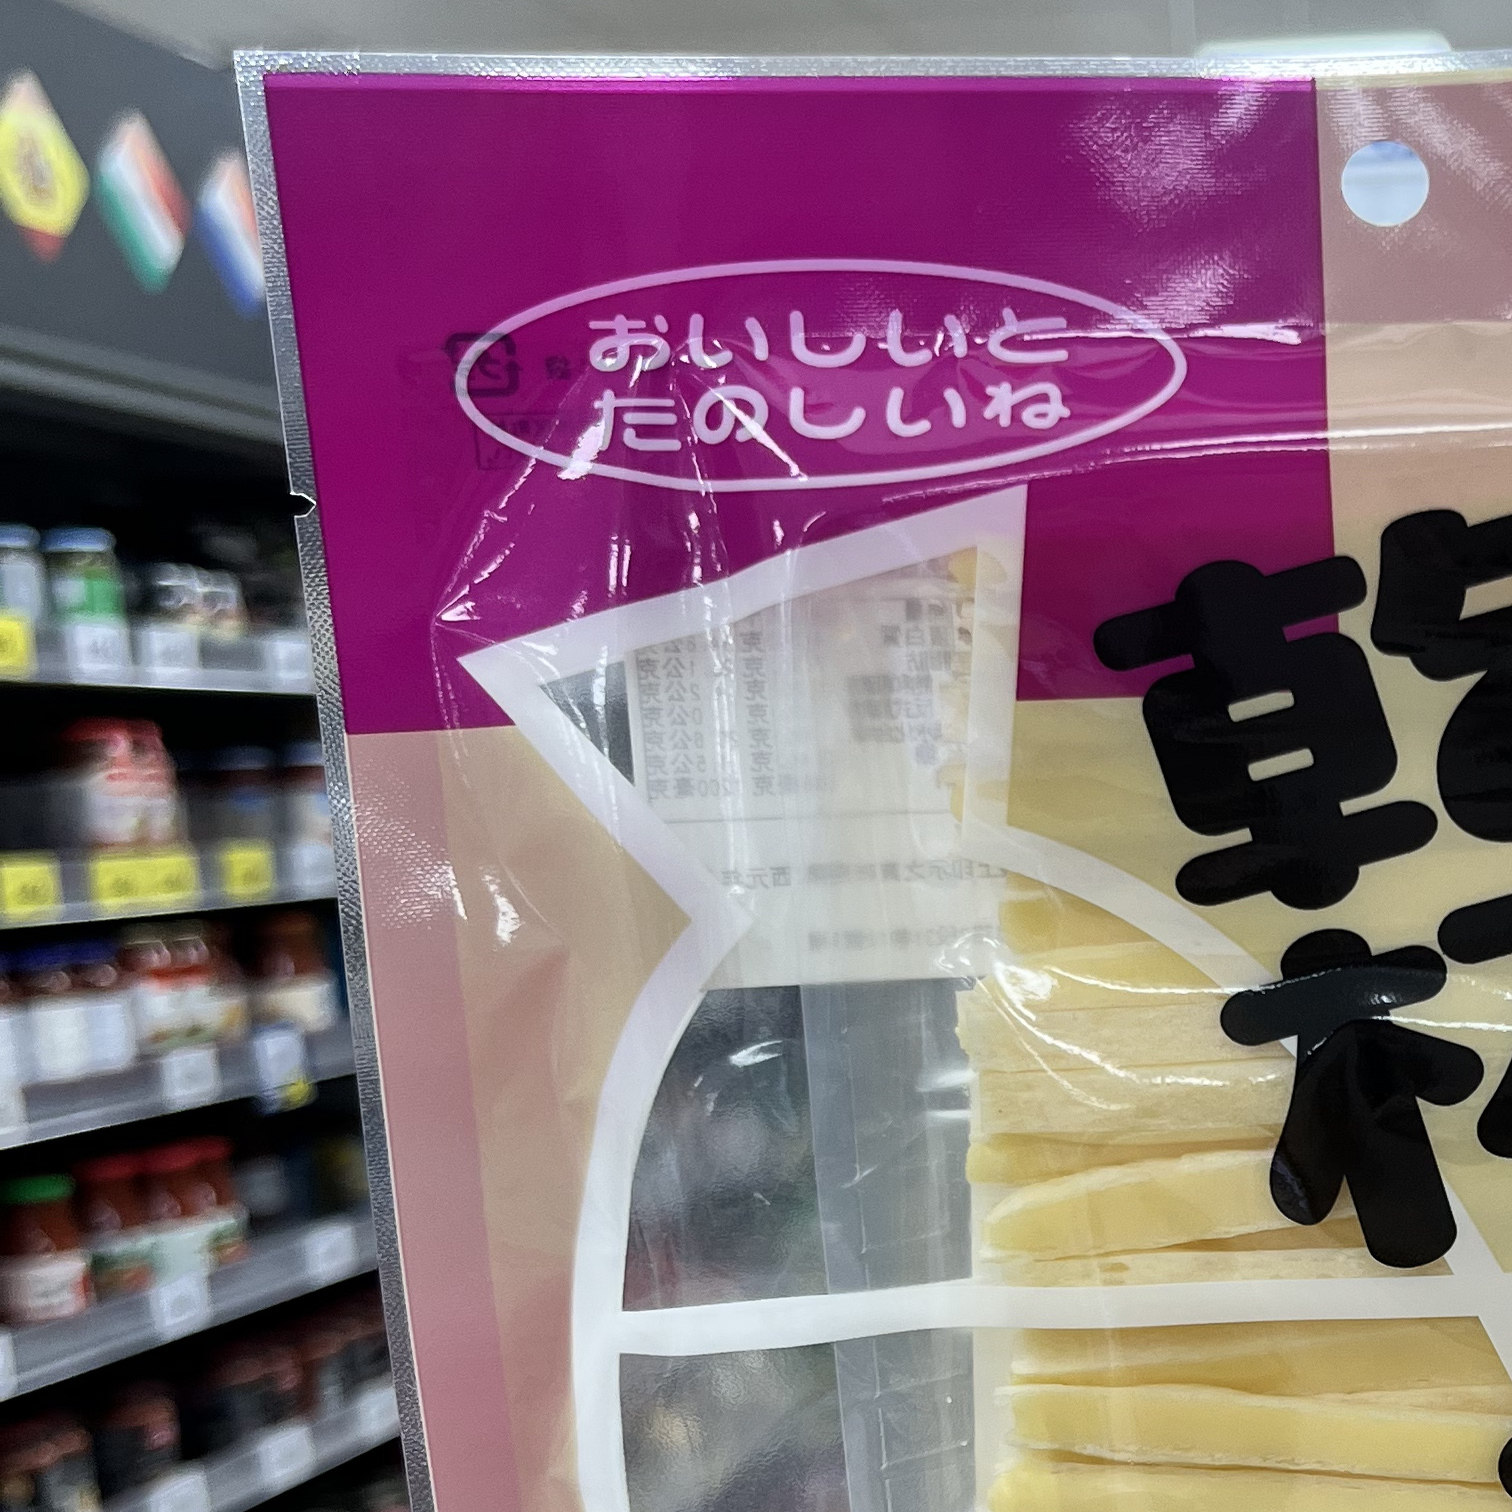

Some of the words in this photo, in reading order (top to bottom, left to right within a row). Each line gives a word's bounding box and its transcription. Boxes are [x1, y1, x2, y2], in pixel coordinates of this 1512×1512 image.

[588, 307, 1070, 372] おいしいと
[592, 381, 1071, 452] たのしいね
